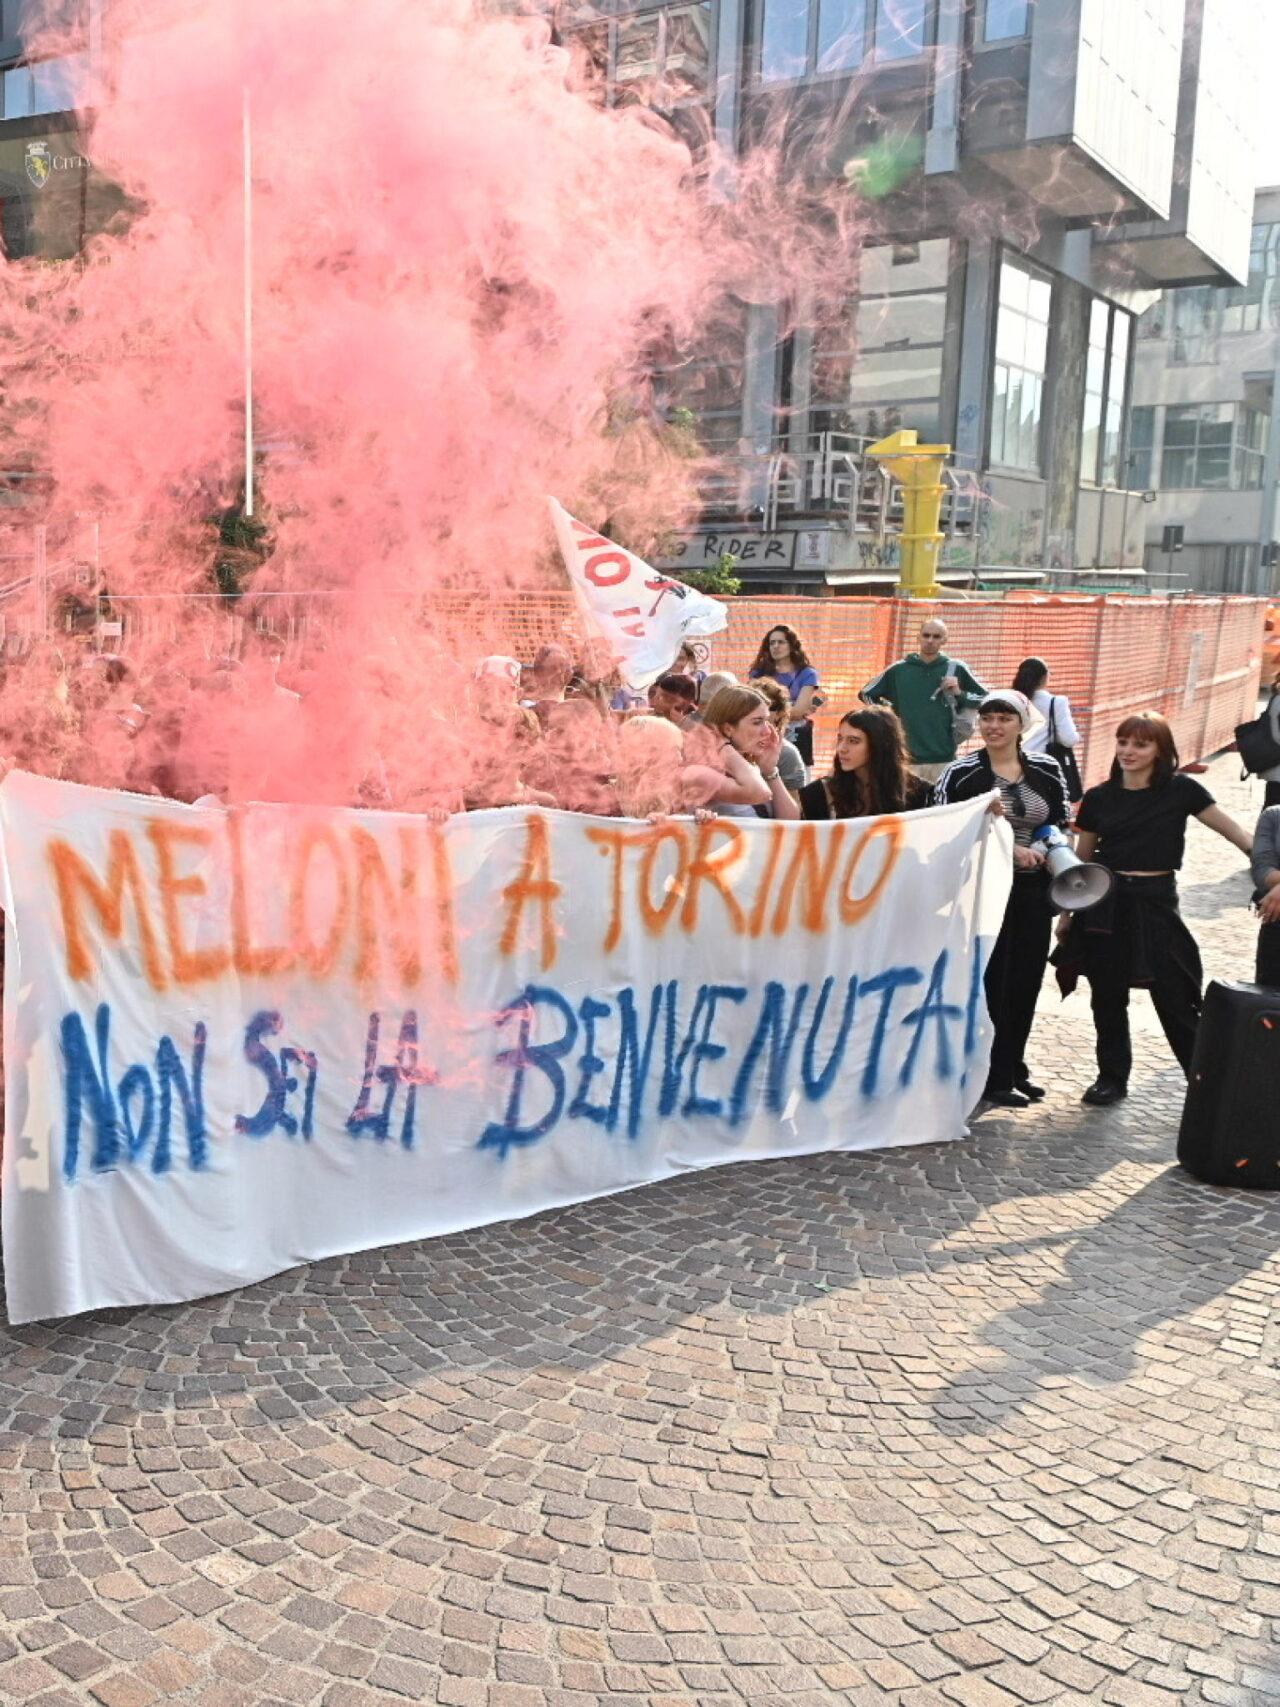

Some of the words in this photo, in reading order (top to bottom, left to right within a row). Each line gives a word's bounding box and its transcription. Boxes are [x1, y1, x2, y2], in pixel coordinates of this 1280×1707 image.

[45, 806, 460, 991] MELONI
[498, 812, 563, 972] A
[583, 814, 907, 954] TORINO
[345, 1008, 440, 1151] LA
[474, 934, 983, 1164] BENVENUTA!
